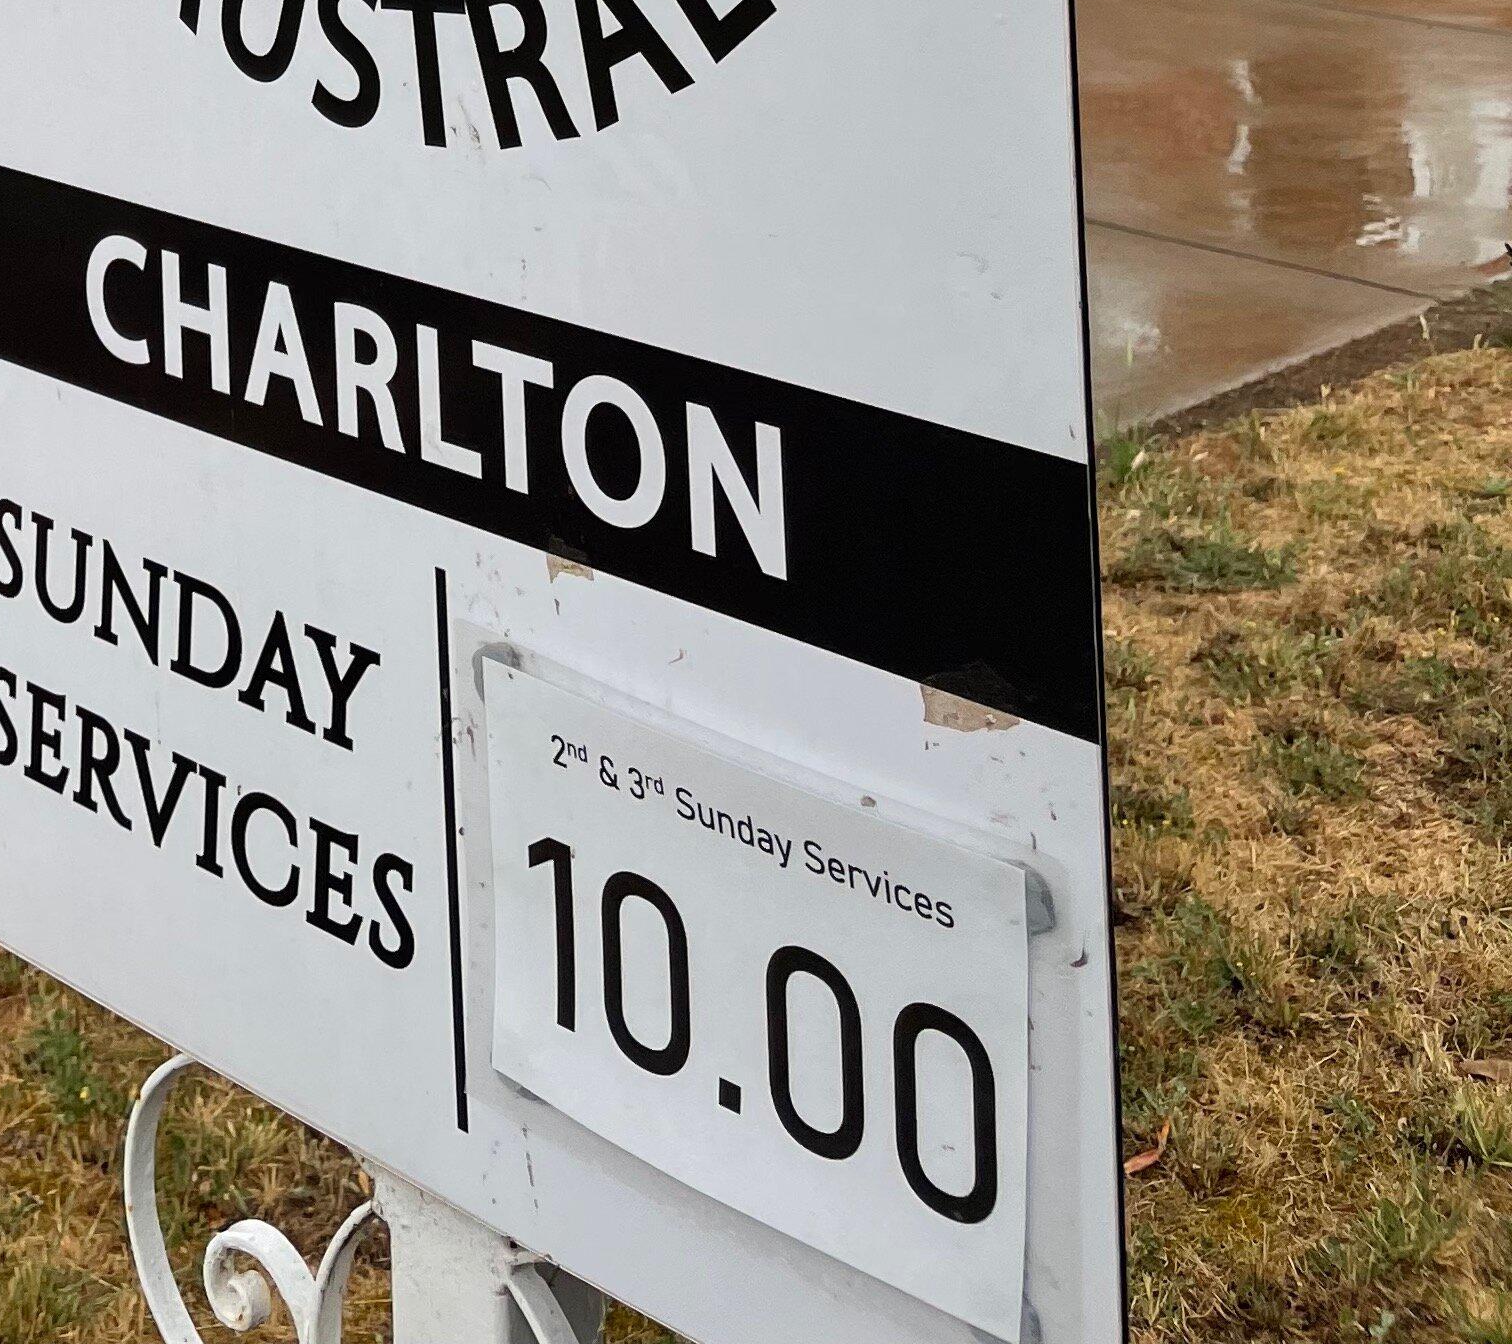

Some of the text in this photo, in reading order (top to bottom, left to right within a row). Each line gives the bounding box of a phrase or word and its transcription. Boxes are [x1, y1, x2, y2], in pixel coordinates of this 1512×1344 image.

[85, 233, 788, 581] CHARLTON
[550, 734, 955, 929] 2nd & 3rd Sunday Services
[526, 835, 998, 1225] 10.00
